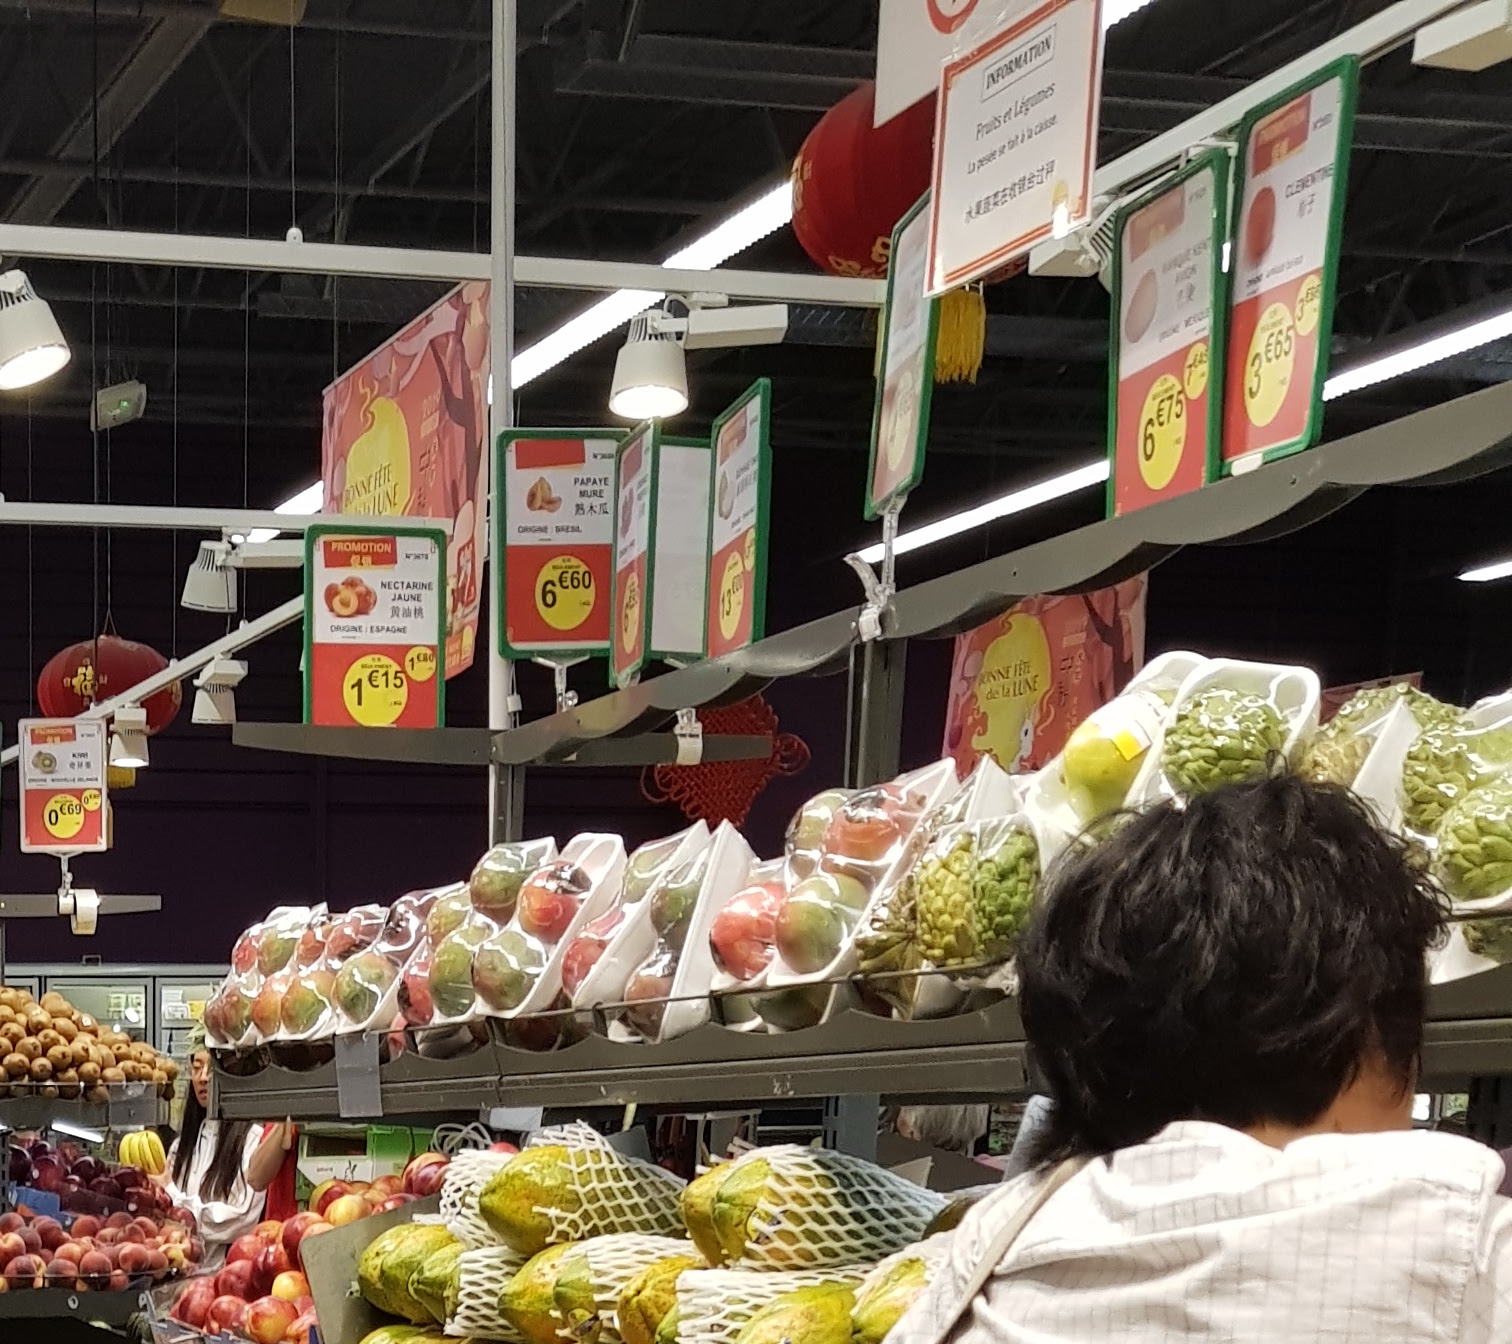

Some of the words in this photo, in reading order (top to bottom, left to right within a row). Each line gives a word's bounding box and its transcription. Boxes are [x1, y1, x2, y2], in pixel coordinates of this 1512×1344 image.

[986, 34, 1052, 90] INFORMATION
[976, 112, 1001, 141] Fruits
[1014, 83, 1056, 120] Légumes
[573, 476, 610, 487] PAPAYE
[578, 489, 605, 499] MURE
[331, 541, 392, 554] PROMOTION
[380, 580, 434, 591] NECTARINE
[390, 593, 423, 602] JAUNE
[330, 625, 363, 634] ORIGINE
[369, 625, 408, 635] ESPAGNE
[1012, 674, 1040, 697] LUNE
